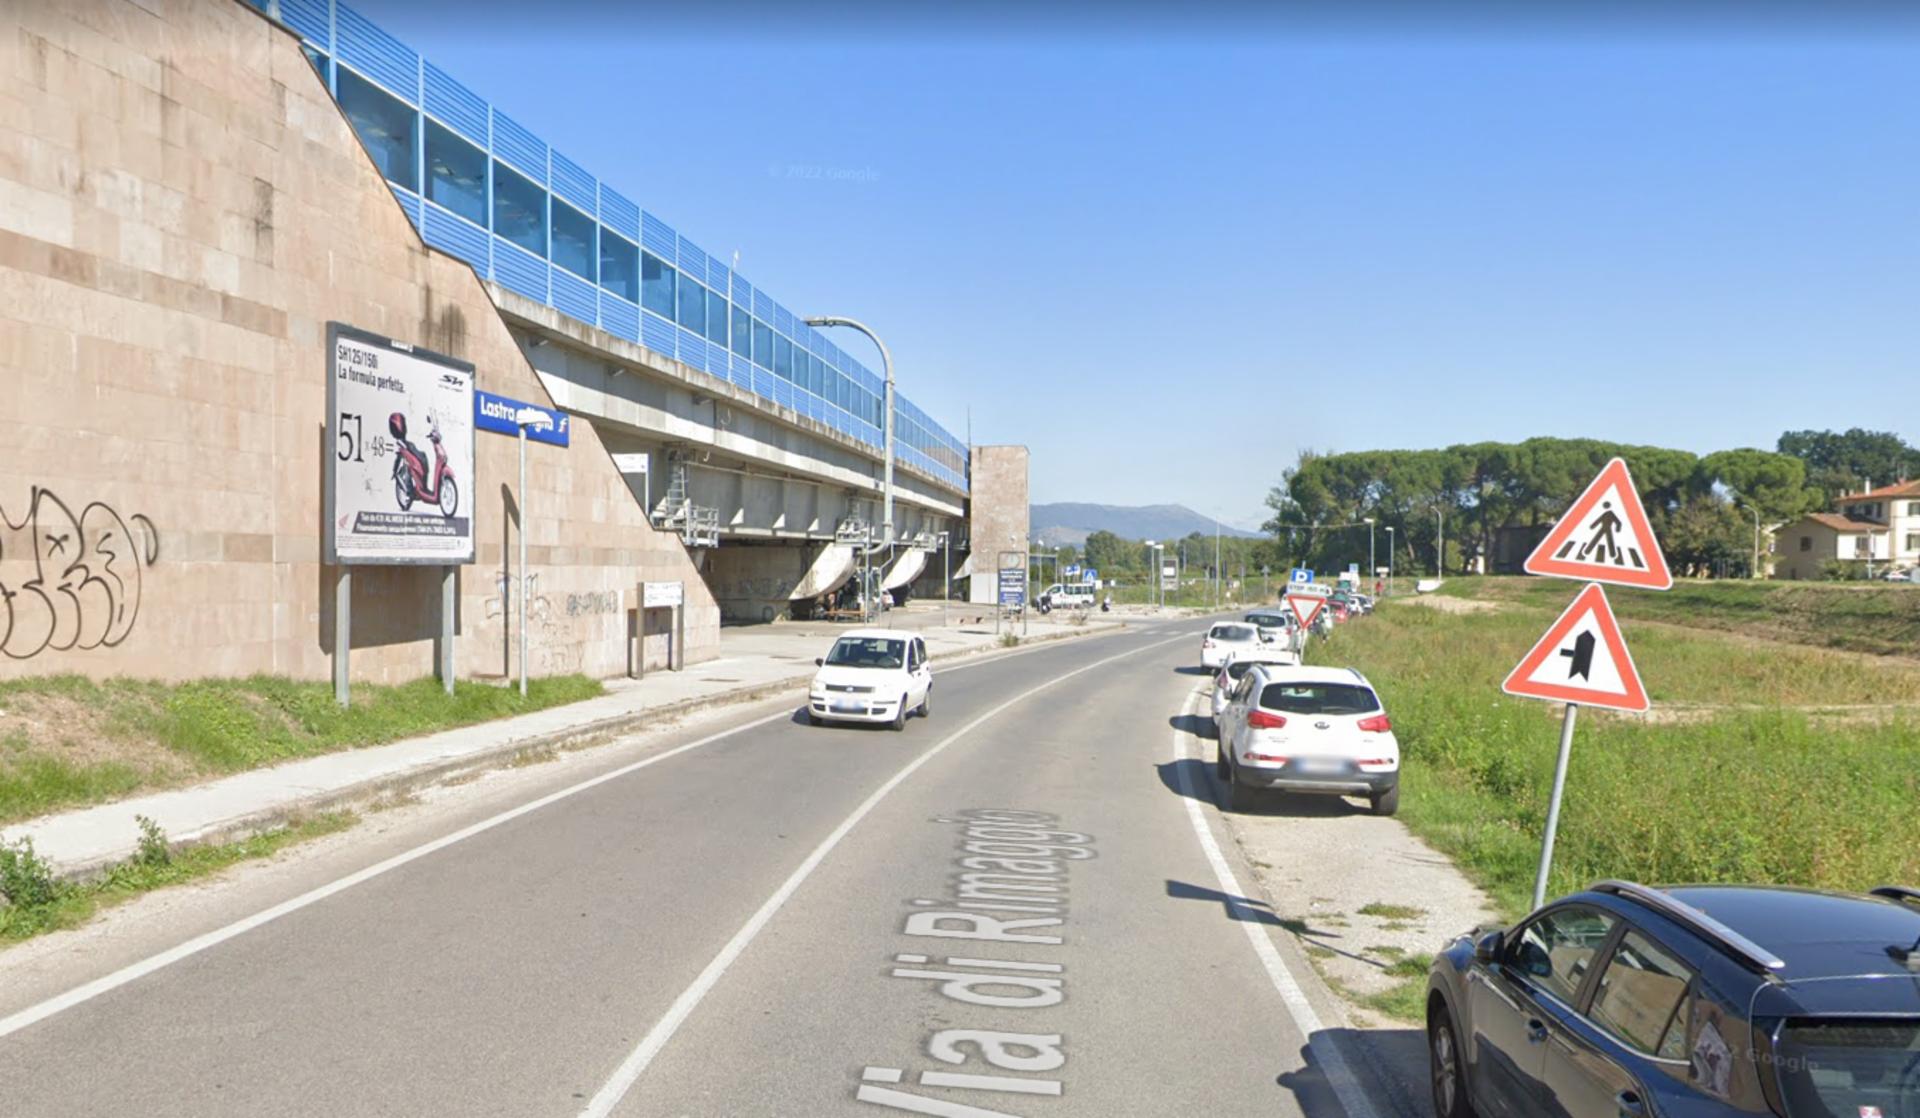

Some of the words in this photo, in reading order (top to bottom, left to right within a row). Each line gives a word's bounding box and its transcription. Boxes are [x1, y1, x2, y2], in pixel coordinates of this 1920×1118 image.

[338, 344, 379, 369] SH125/150i
[338, 363, 347, 380] La
[348, 366, 376, 387] formula
[480, 394, 515, 422] Lastra
[338, 412, 365, 463] 51
[1296, 571, 1308, 582] P
[904, 808, 1097, 945] Rimaggio
[892, 954, 1064, 1008] di
